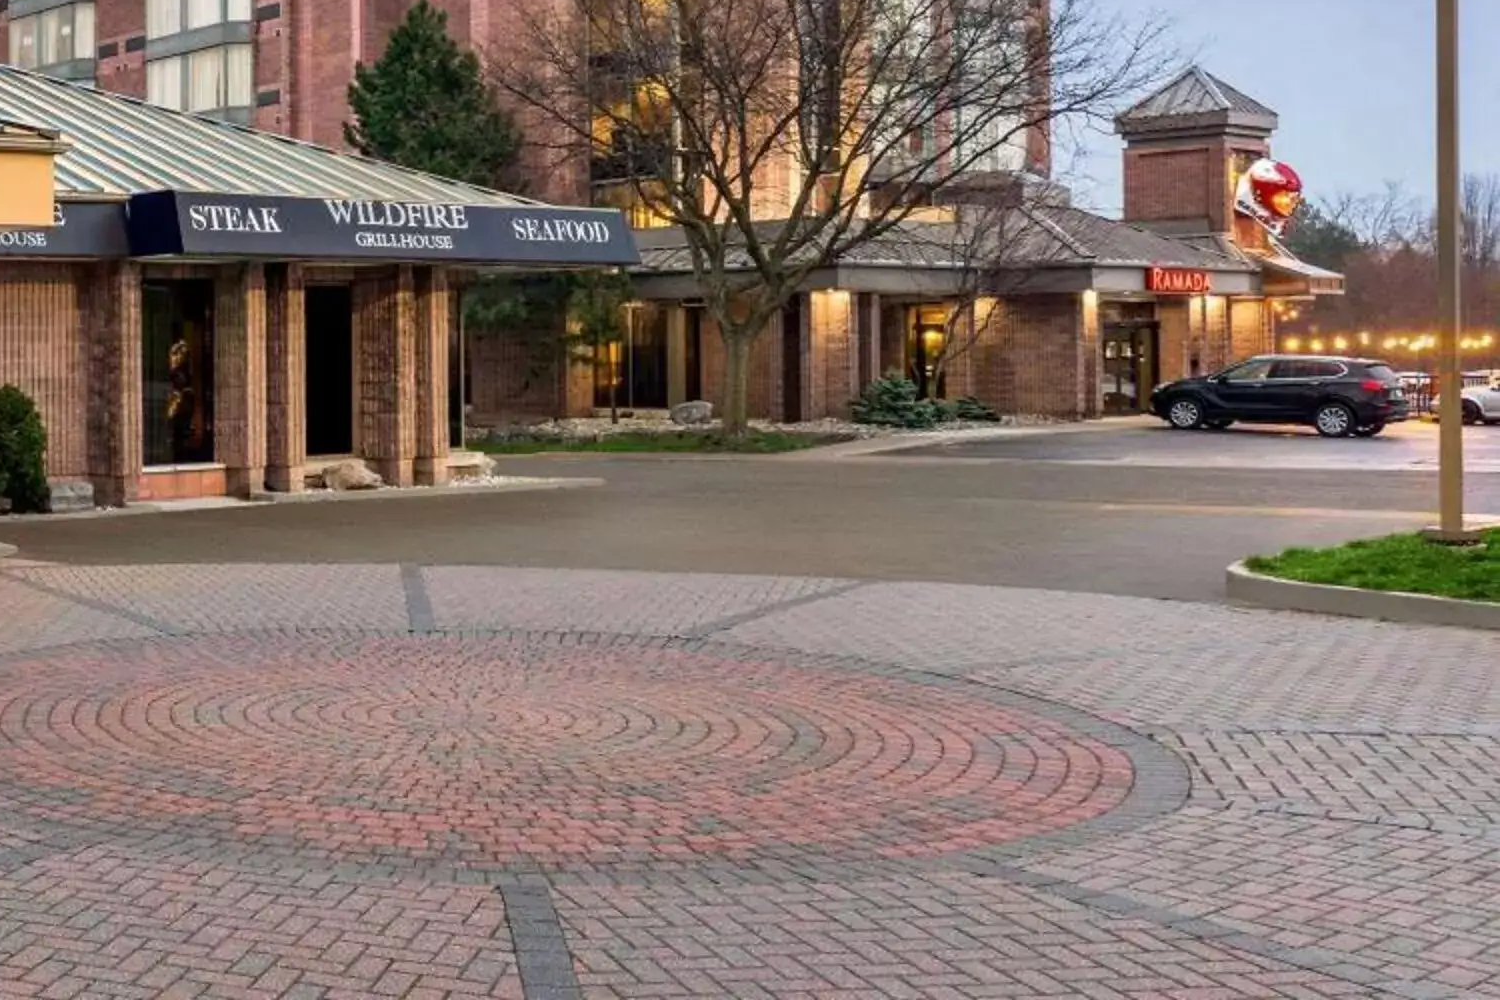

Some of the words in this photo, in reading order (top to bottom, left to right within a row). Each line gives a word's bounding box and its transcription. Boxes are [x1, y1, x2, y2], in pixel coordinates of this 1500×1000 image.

[189, 205, 281, 233] STEAK
[324, 200, 469, 230] WILDFIRE
[355, 231, 453, 249] GRILLHOUSE
[512, 217, 610, 243] SEAFOOD
[1153, 267, 1213, 291] RAMADA
